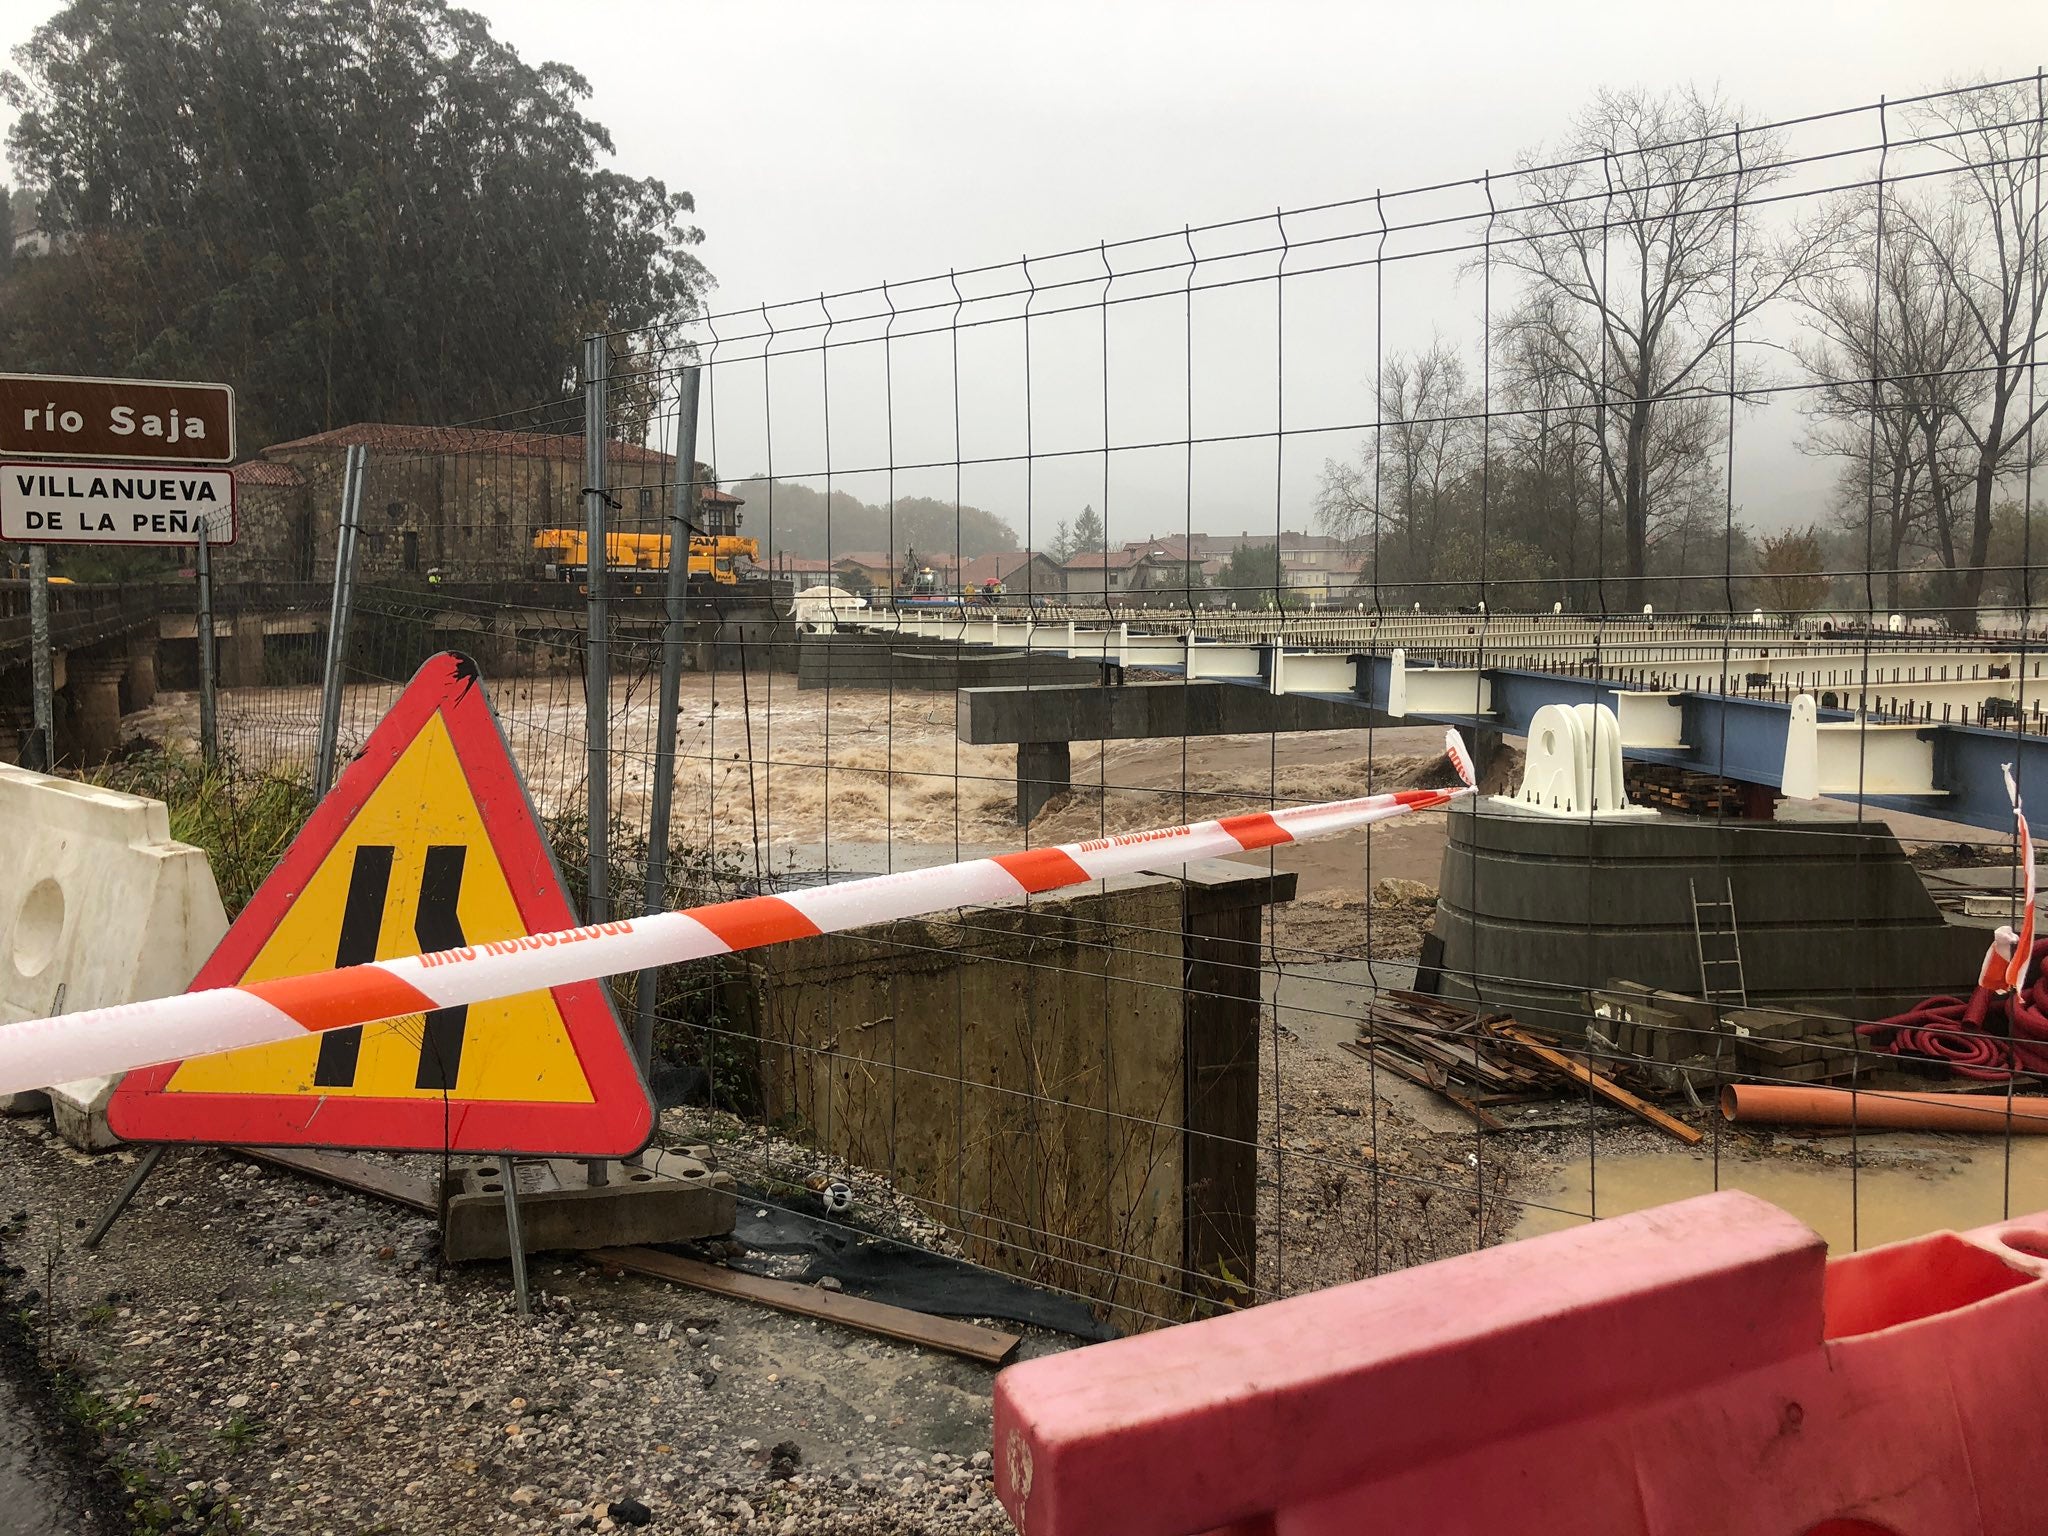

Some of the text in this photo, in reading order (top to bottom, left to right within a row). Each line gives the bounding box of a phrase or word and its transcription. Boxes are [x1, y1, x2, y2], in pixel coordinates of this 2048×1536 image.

[24, 402, 206, 443] río Saja
[16, 475, 217, 502] VILLANUEVA
[26, 511, 63, 530] DE
[80, 512, 116, 532] LA
